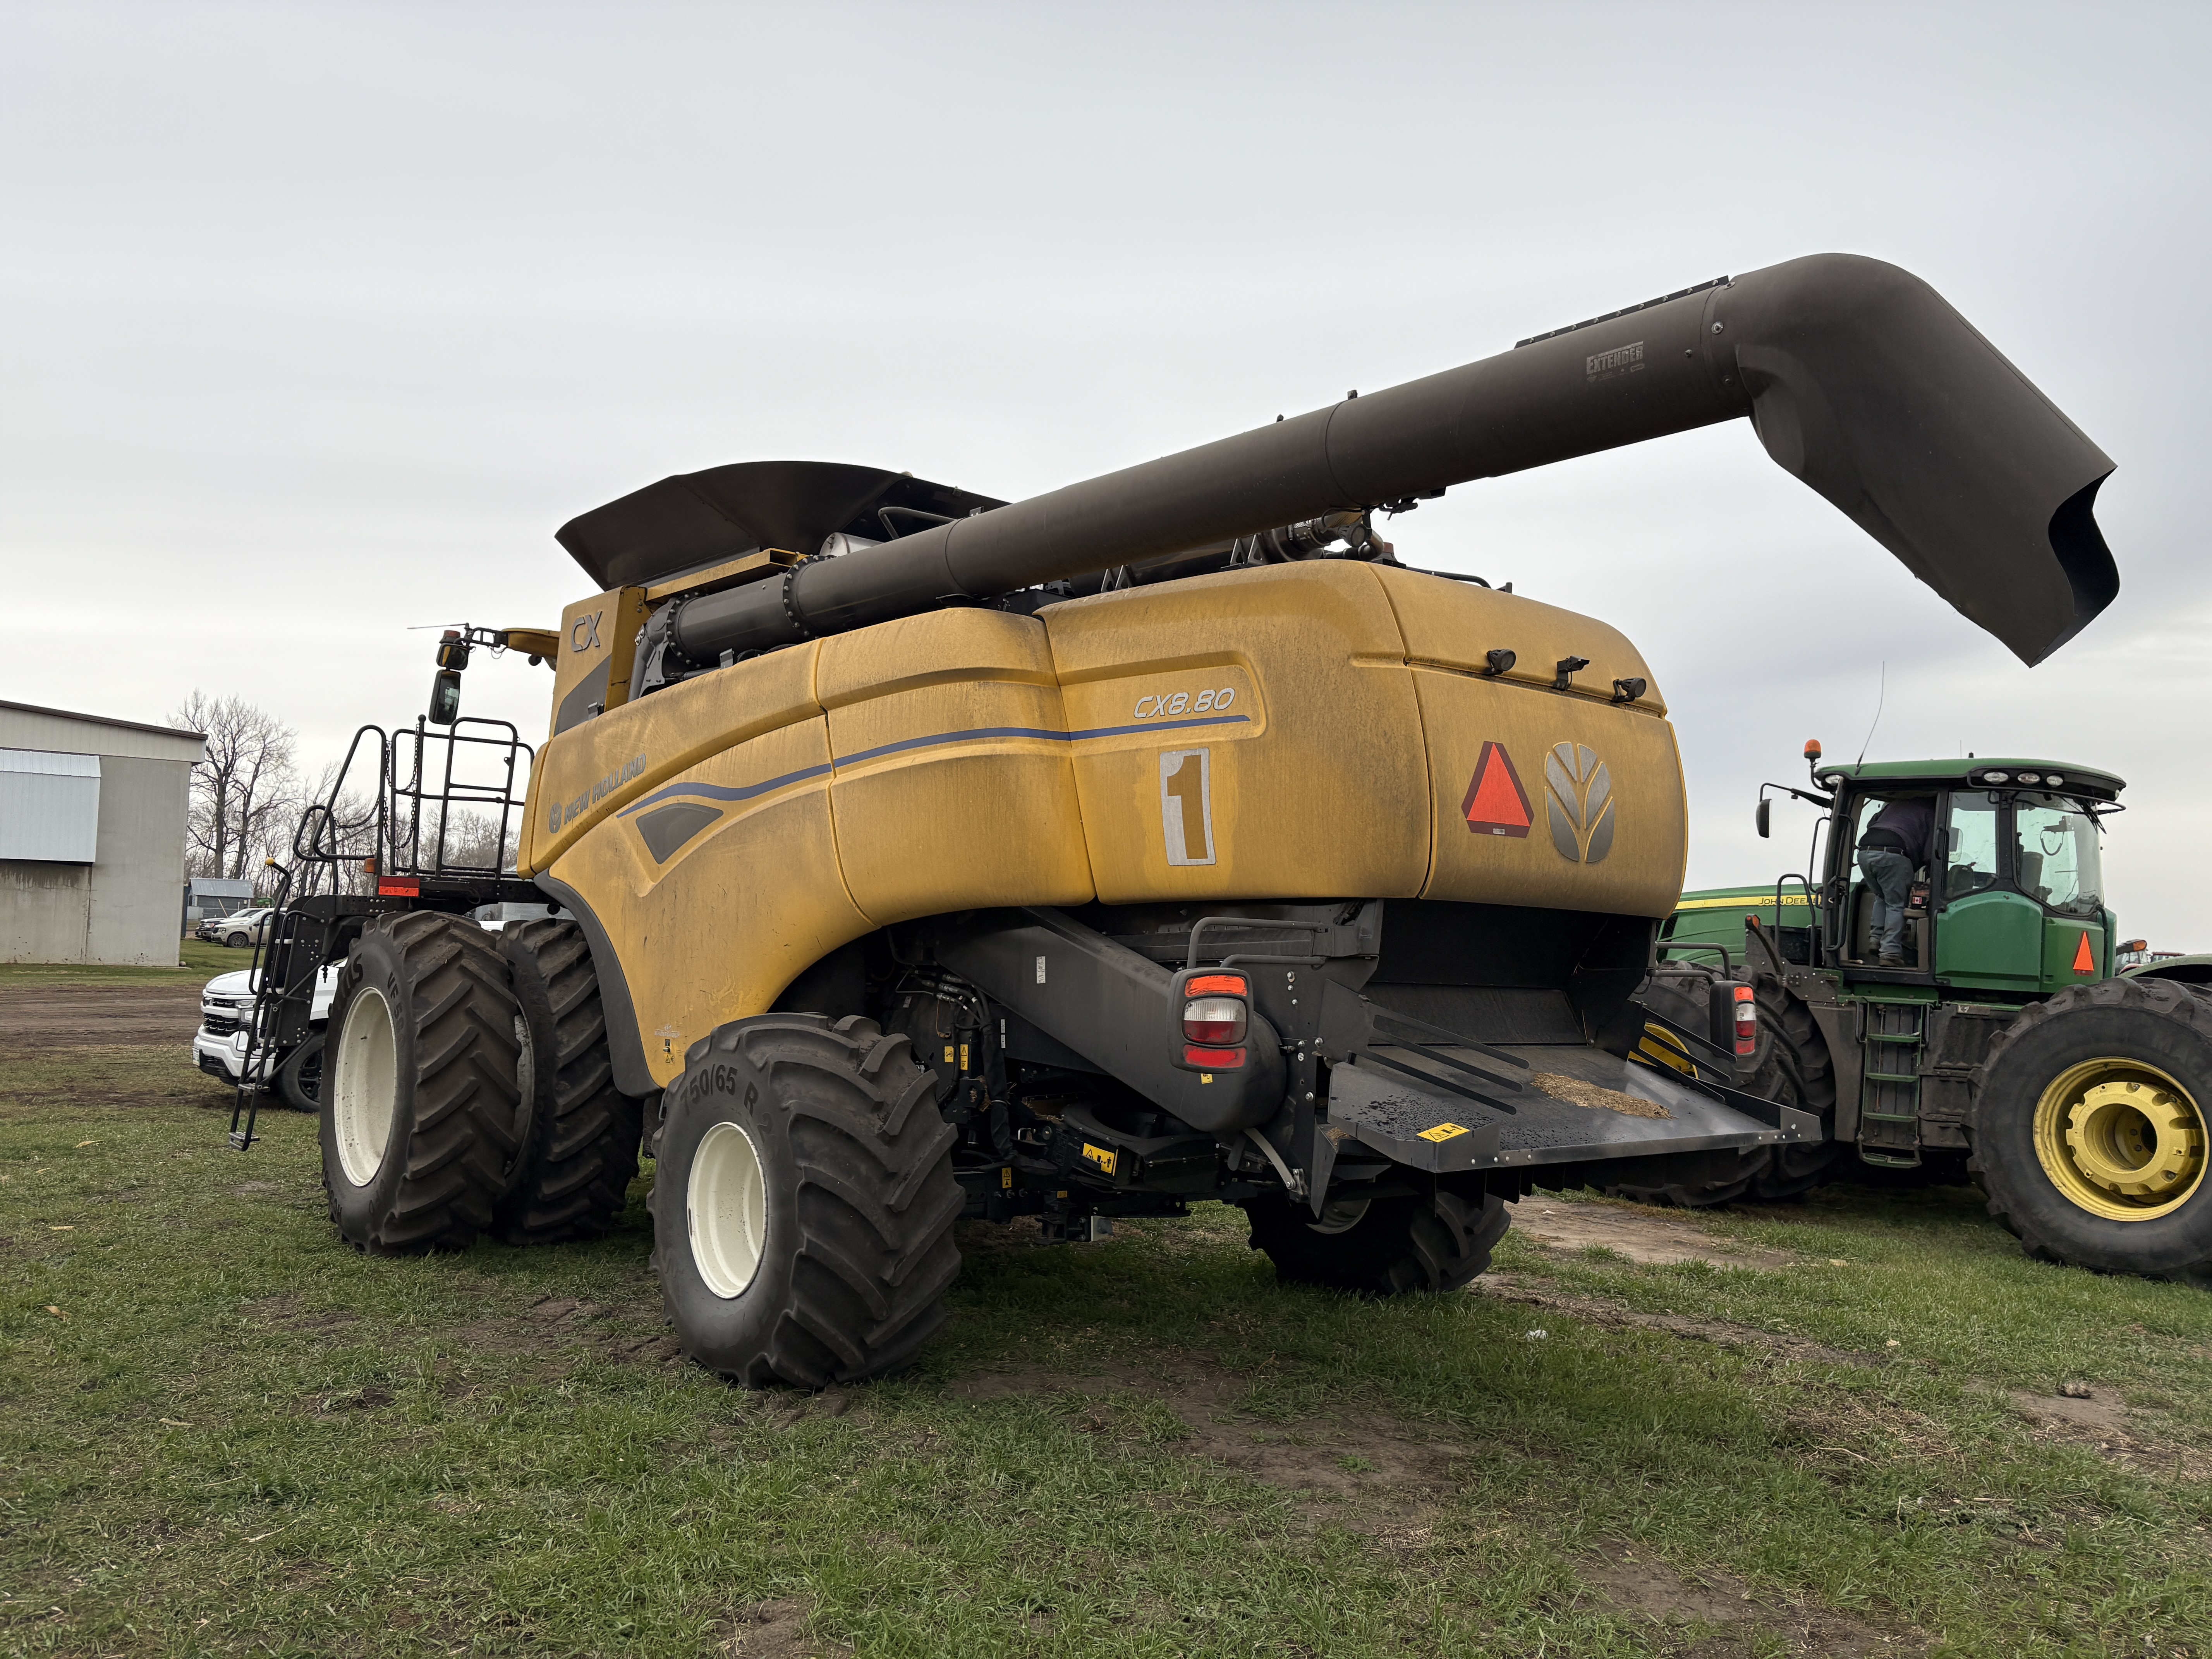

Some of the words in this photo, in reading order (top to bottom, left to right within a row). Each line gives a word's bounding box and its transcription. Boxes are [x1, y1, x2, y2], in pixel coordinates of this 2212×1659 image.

[1586, 341, 1644, 375] EXTENDER
[571, 611, 603, 652] CX
[1134, 687, 1235, 718] CX8.80
[564, 788, 590, 825] NEW
[592, 753, 646, 804] HOLLAND
[1166, 754, 1208, 860] 1
[680, 1063, 738, 1116] 750/65
[744, 1081, 759, 1118] R
